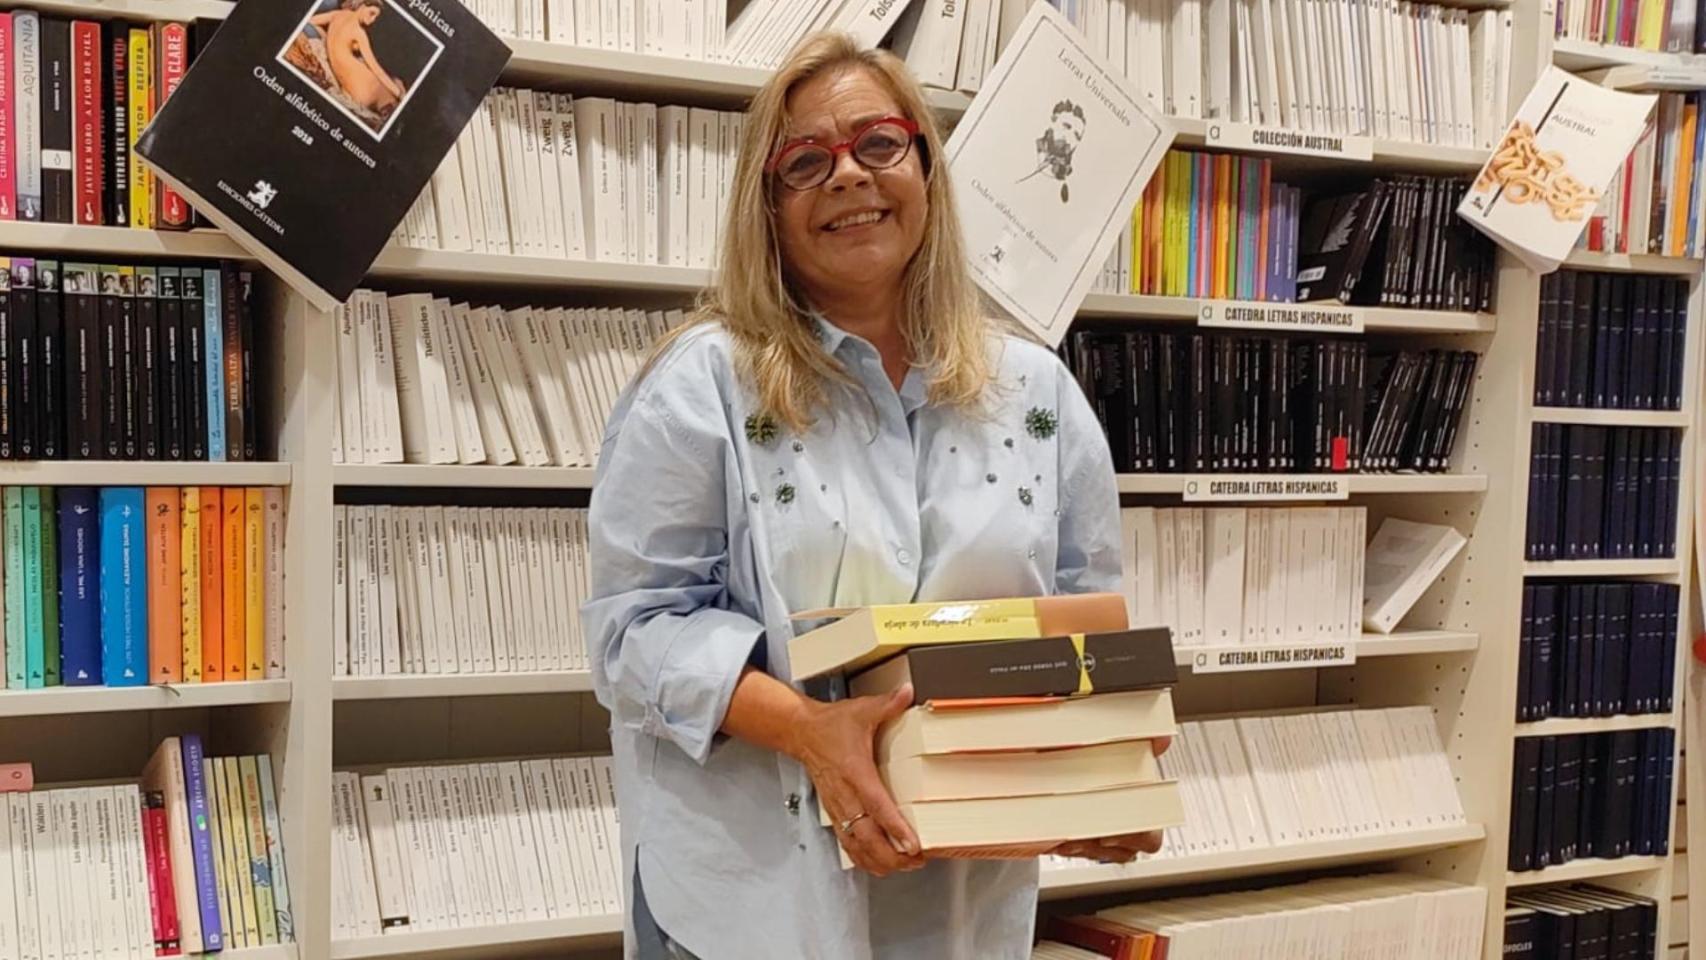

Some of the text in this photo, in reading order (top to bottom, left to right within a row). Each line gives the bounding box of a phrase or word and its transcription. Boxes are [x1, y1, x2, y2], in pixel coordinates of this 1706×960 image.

[869, 0, 895, 21] Tols
[23, 18, 35, 96] AQUITANIA
[84, 61, 92, 74] DE
[168, 36, 181, 72] CLARE
[1057, 48, 1132, 127] Letras Universales
[252, 66, 376, 169] Orden alfabético de autores
[291, 125, 314, 147] 2018
[540, 117, 554, 154] Zweig
[560, 120, 572, 156] Zweig
[1252, 130, 1303, 148] COLECCIÓN
[1304, 135, 1344, 152] AUSTRAL
[85, 157, 93, 194] JAVIER
[216, 179, 259, 211] EDICIONES
[418, 305, 434, 358] Tucídides
[1225, 306, 1265, 322] CATEDRA
[1267, 308, 1298, 324] LETRAS
[1300, 310, 1352, 326] HISPANICAS
[229, 352, 238, 376] ALTA
[230, 380, 238, 411] TERRA
[1210, 482, 1250, 495] CATEDRA
[1252, 482, 1284, 495] LETRAS
[1286, 480, 1338, 494] HISPANICAS
[1219, 652, 1258, 666] CATEDRA
[1260, 650, 1292, 665] LETRAS
[1292, 647, 1345, 663] HISPANICAS
[36, 802, 47, 834] Walden
